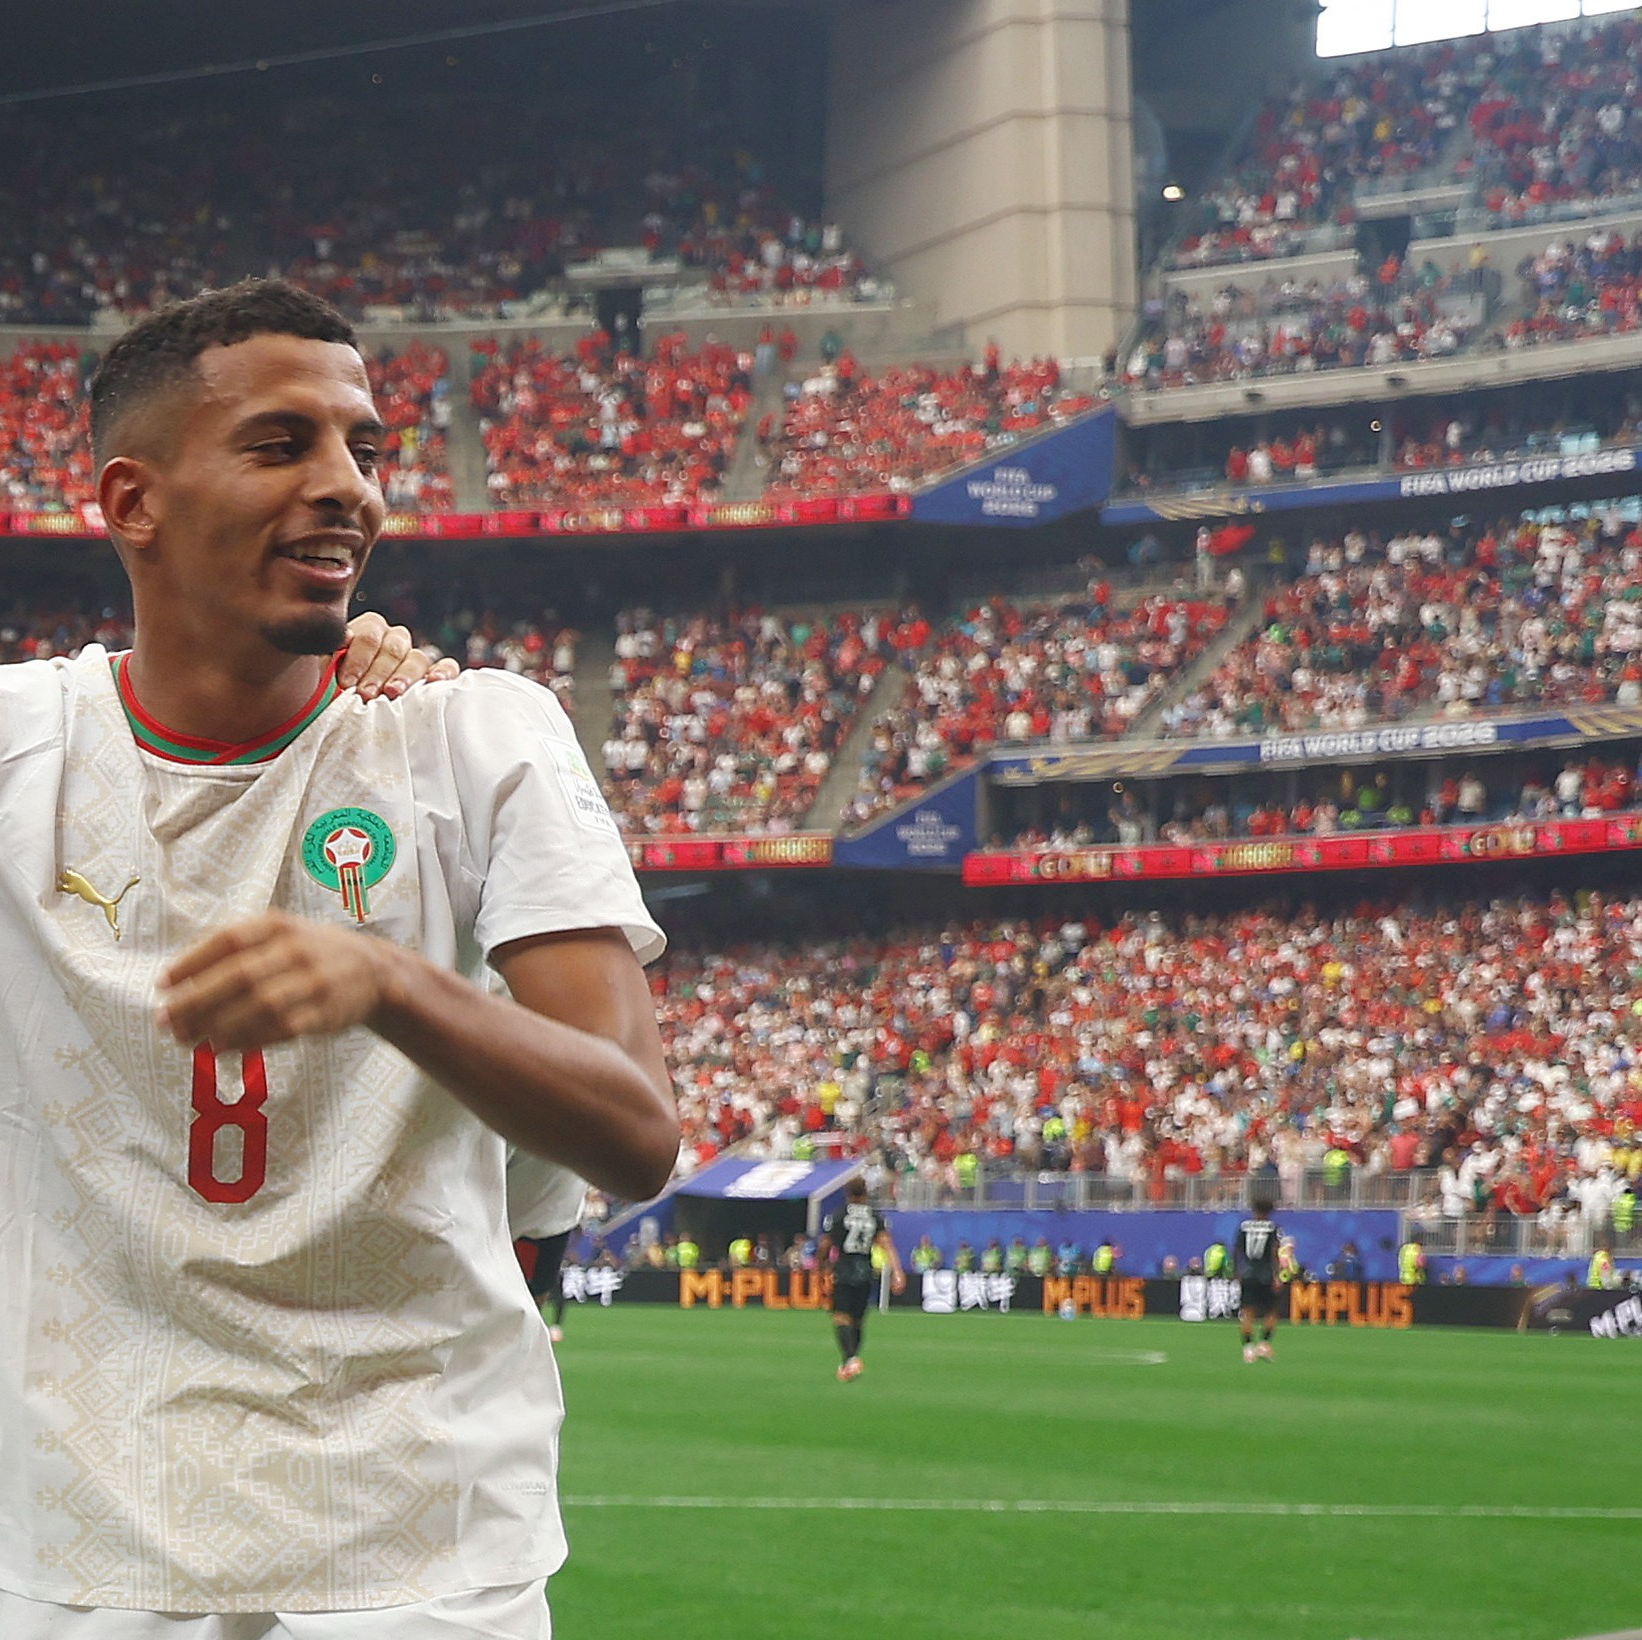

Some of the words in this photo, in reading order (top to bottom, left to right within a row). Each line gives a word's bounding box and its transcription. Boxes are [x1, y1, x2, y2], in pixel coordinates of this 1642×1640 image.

[1400, 473, 1448, 497] FIFA
[1448, 464, 1519, 492] WORLD
[1520, 459, 1561, 483] CUP
[1304, 730, 1378, 757] WORLD
[1378, 727, 1420, 752] CUP
[188, 1040, 267, 1204] 8
